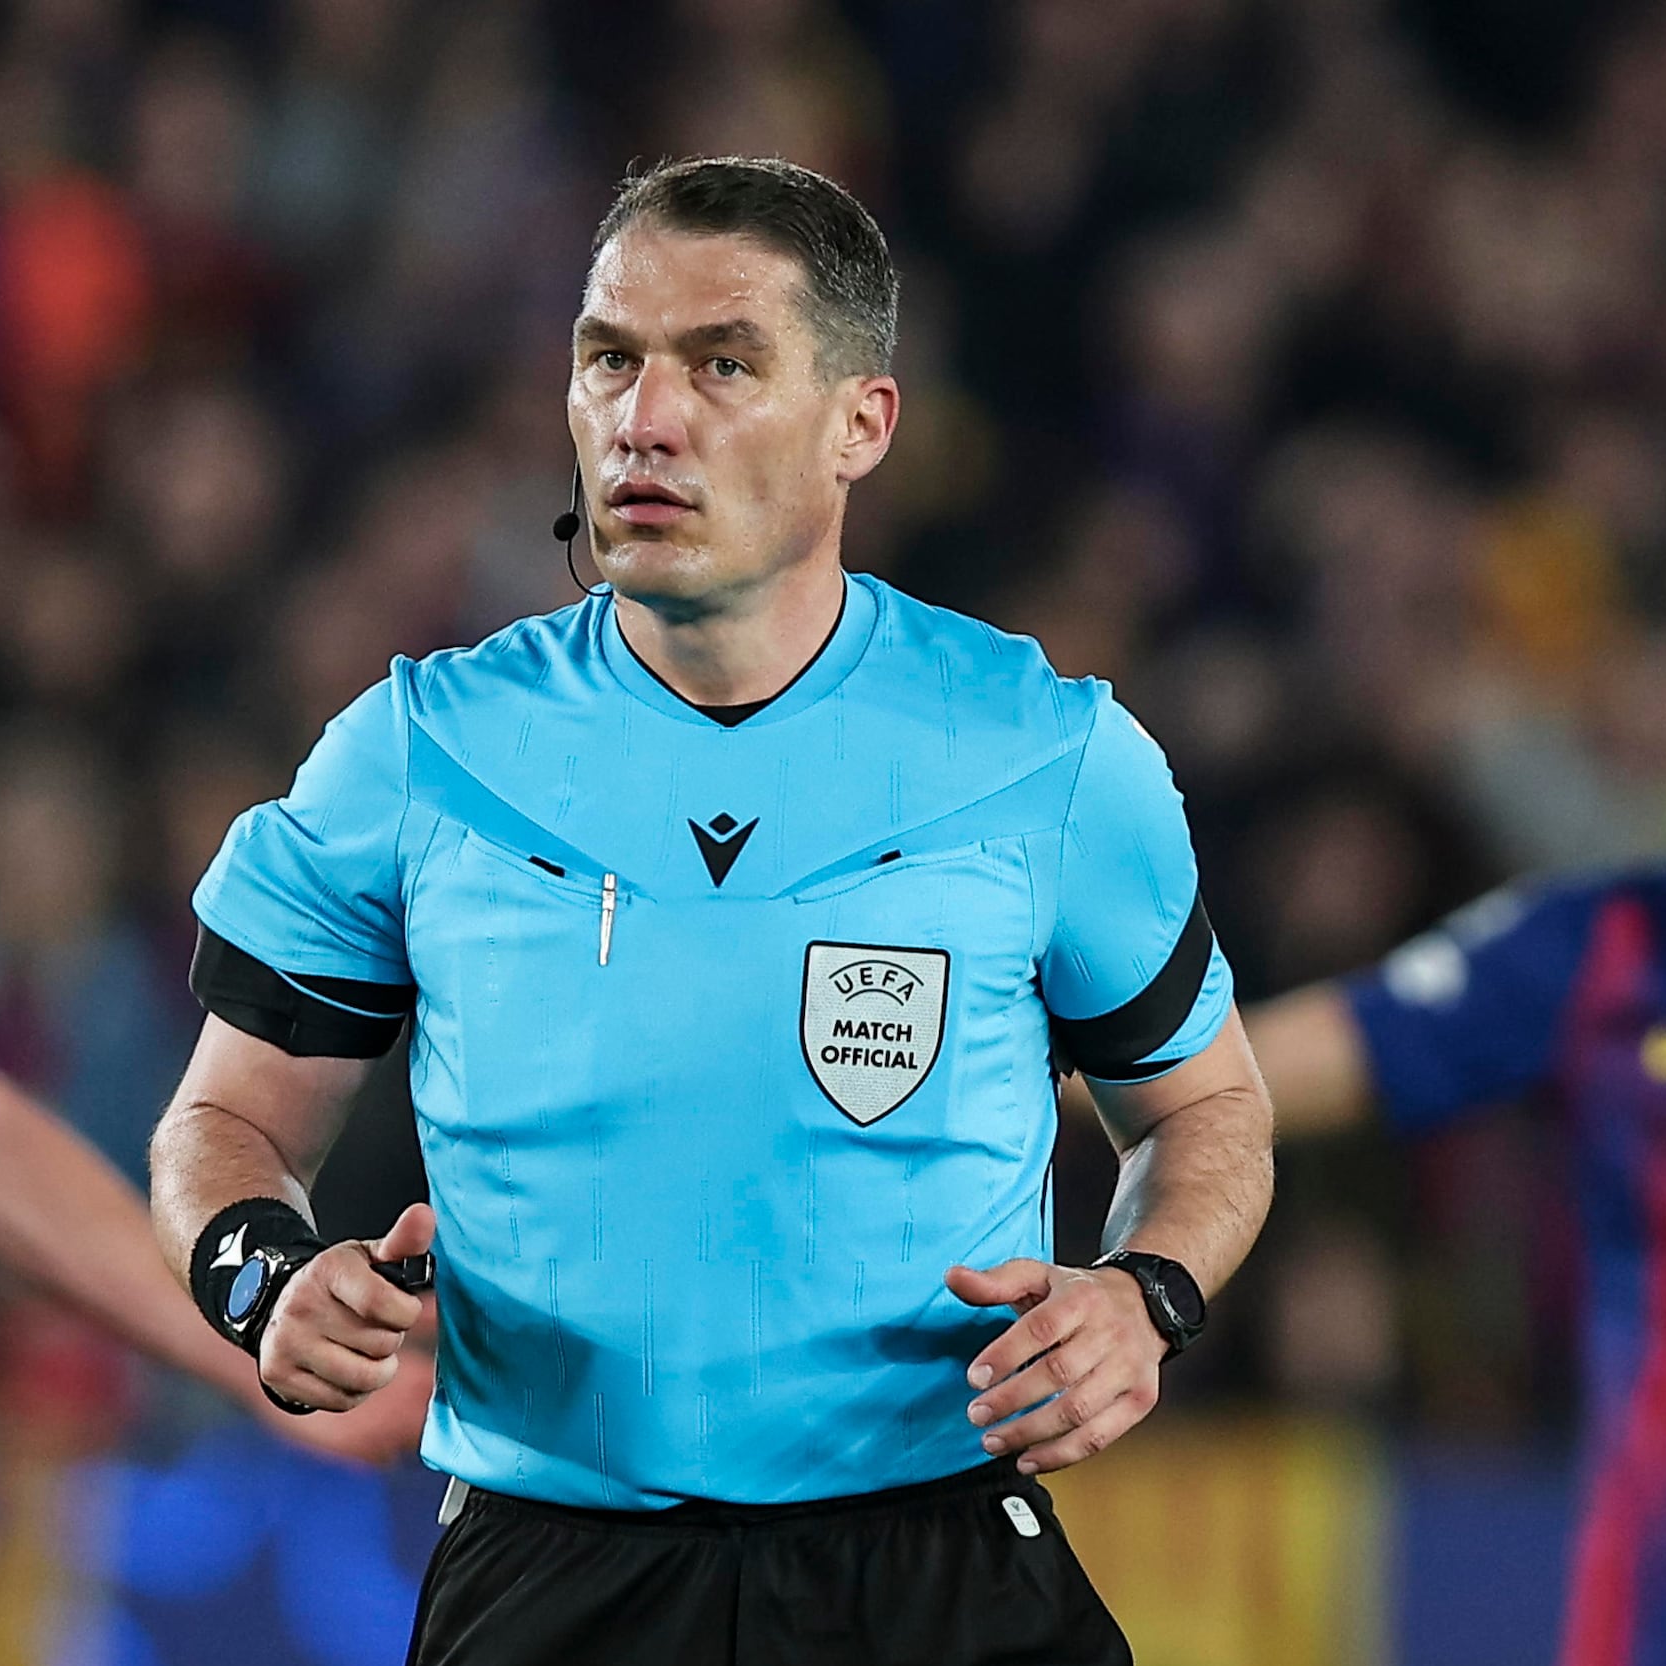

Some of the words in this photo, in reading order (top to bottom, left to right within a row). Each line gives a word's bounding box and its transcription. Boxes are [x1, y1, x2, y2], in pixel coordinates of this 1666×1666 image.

[834, 967, 915, 1002] UEFA
[832, 1020, 913, 1043] MATCH
[820, 1045, 919, 1070] OFFICIAL
